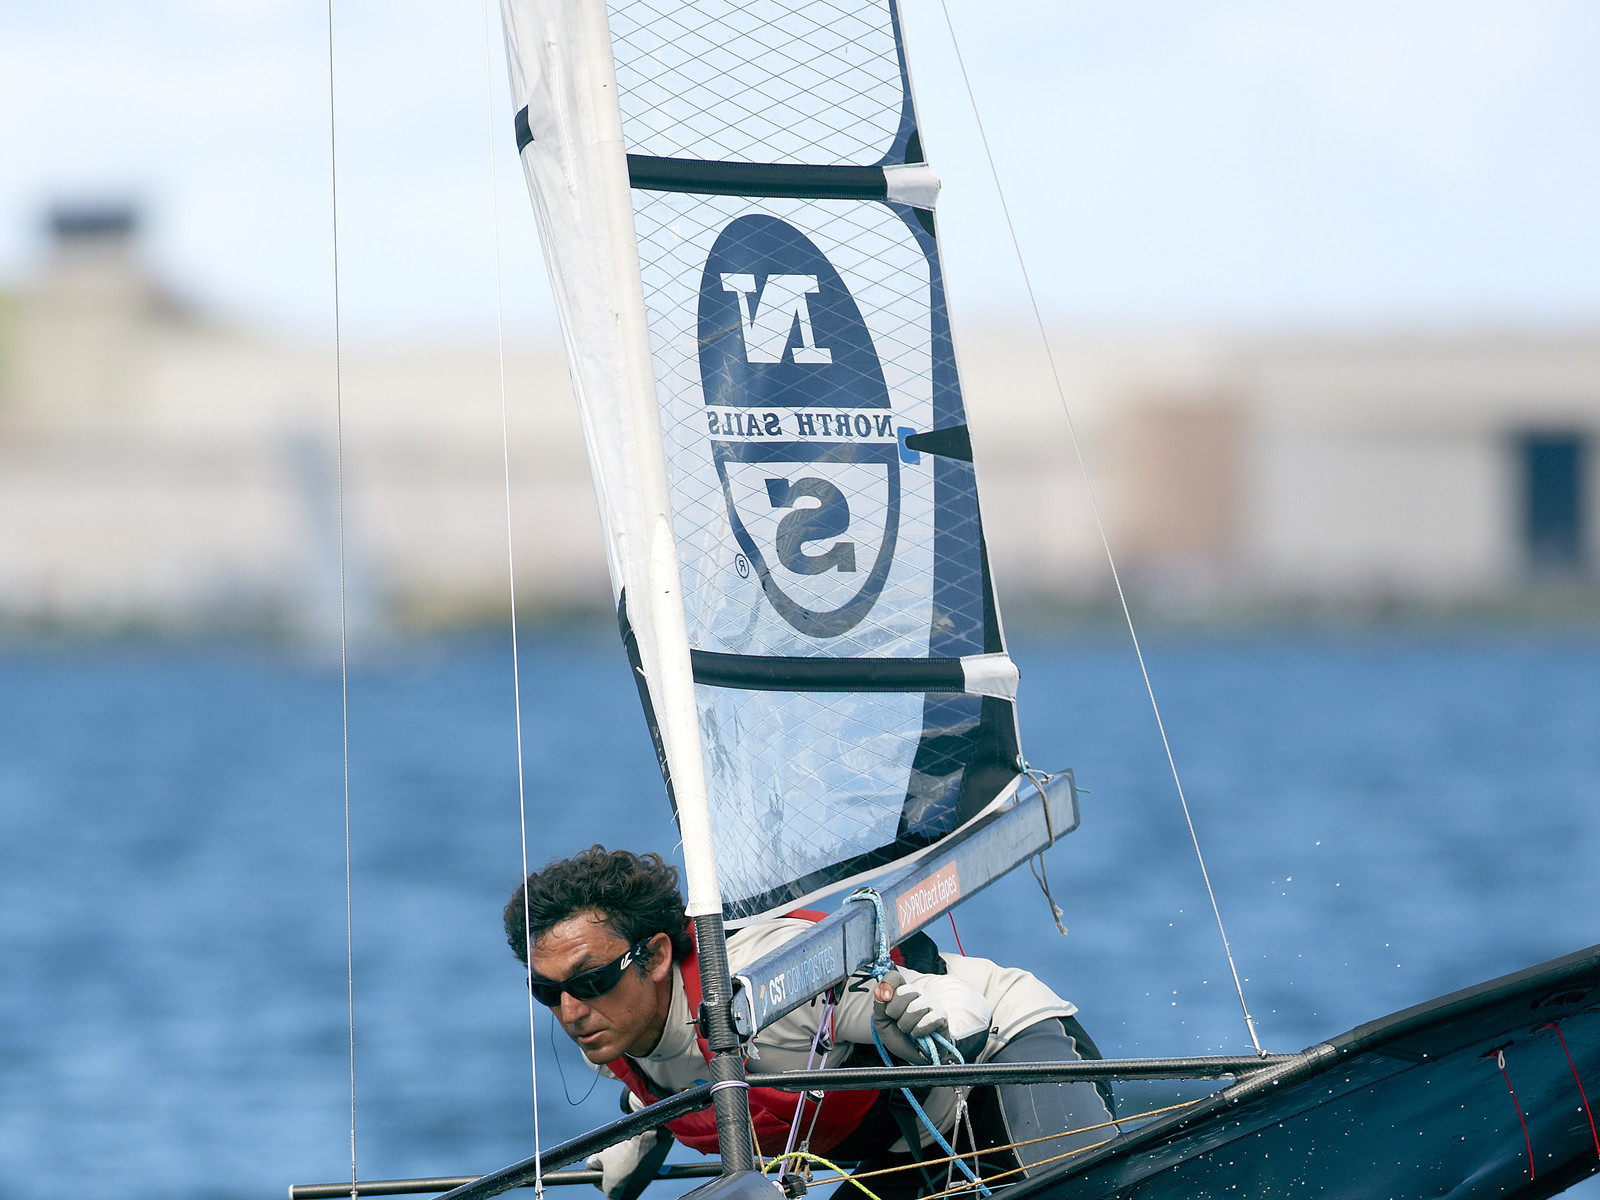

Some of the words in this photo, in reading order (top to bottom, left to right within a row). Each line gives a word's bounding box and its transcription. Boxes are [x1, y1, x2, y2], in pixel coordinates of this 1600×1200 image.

[938, 874, 957, 904] tapes
[769, 973, 786, 1005] CST
[786, 945, 836, 995] COMPOSITES
